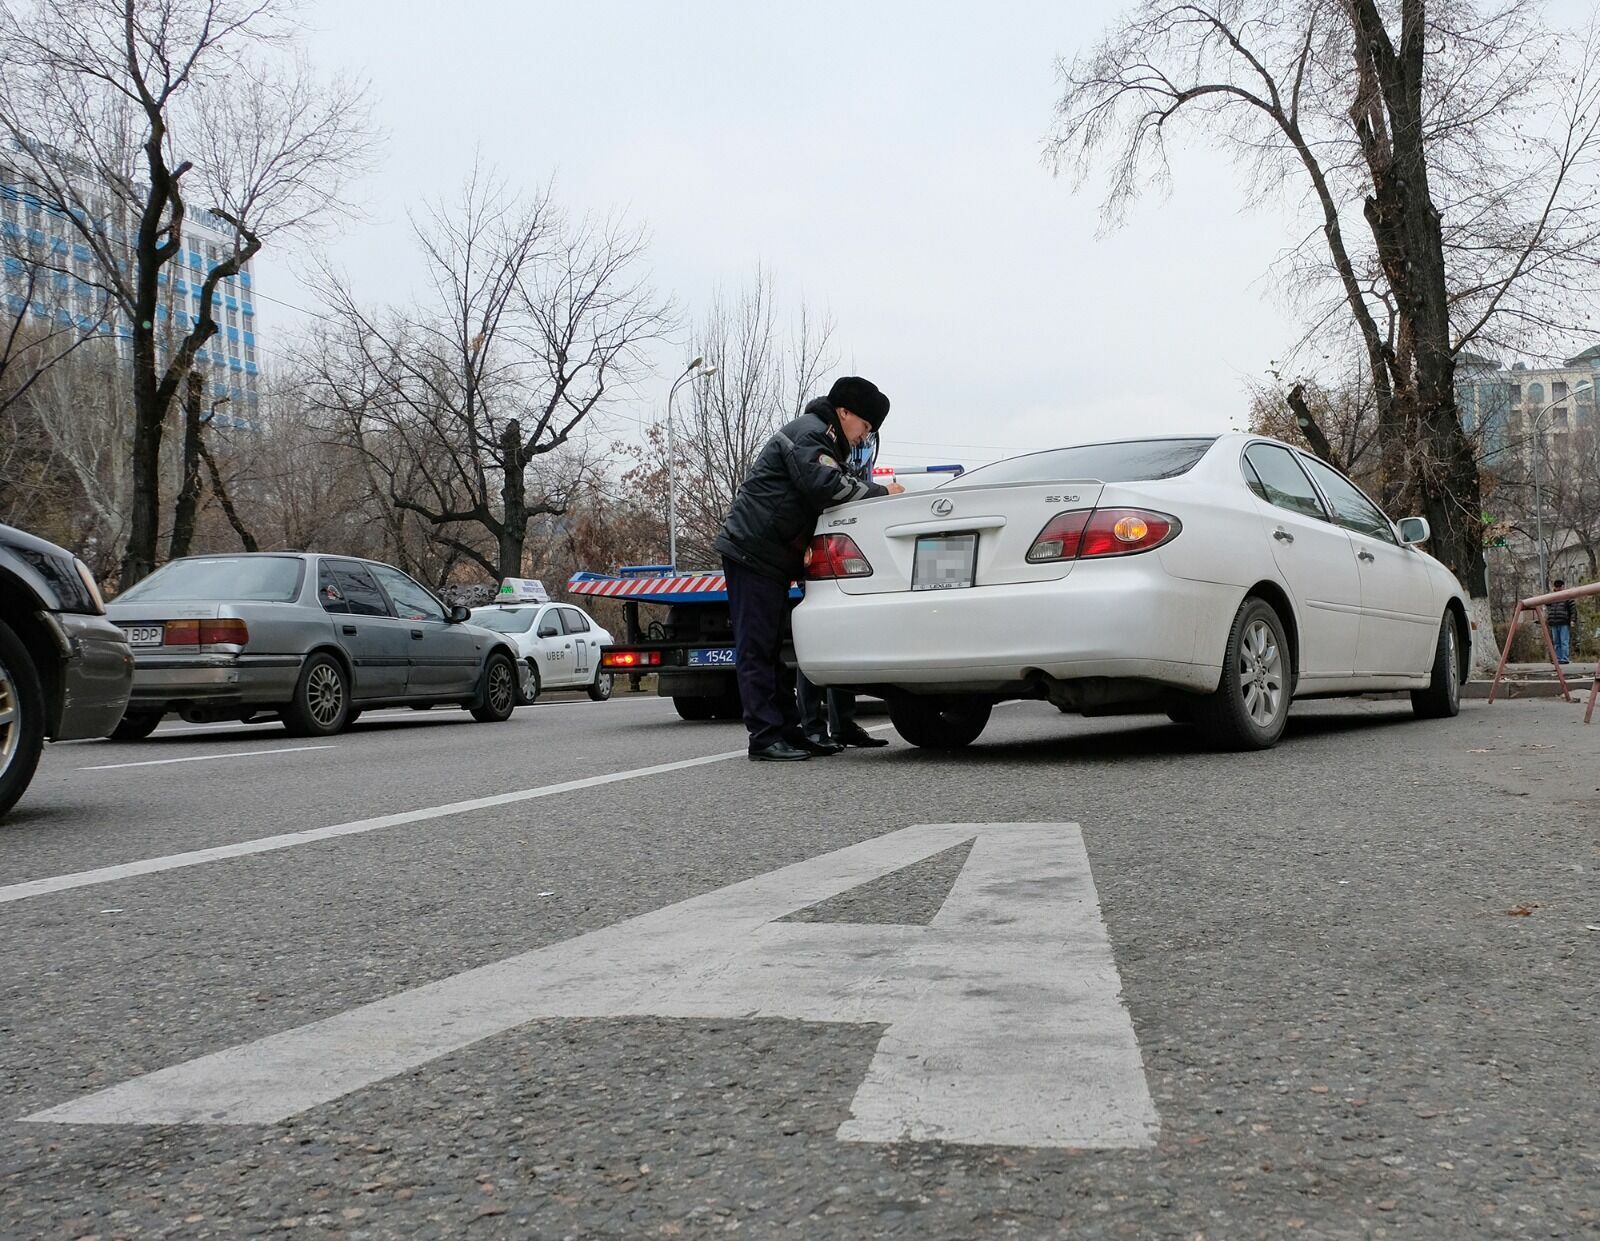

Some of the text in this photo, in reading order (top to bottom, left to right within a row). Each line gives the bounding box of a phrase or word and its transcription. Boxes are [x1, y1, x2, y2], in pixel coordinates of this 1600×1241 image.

[828, 517, 858, 527] LEXUS
[131, 628, 159, 641] BDP
[546, 650, 565, 661] UBER
[705, 650, 733, 662] 1542
